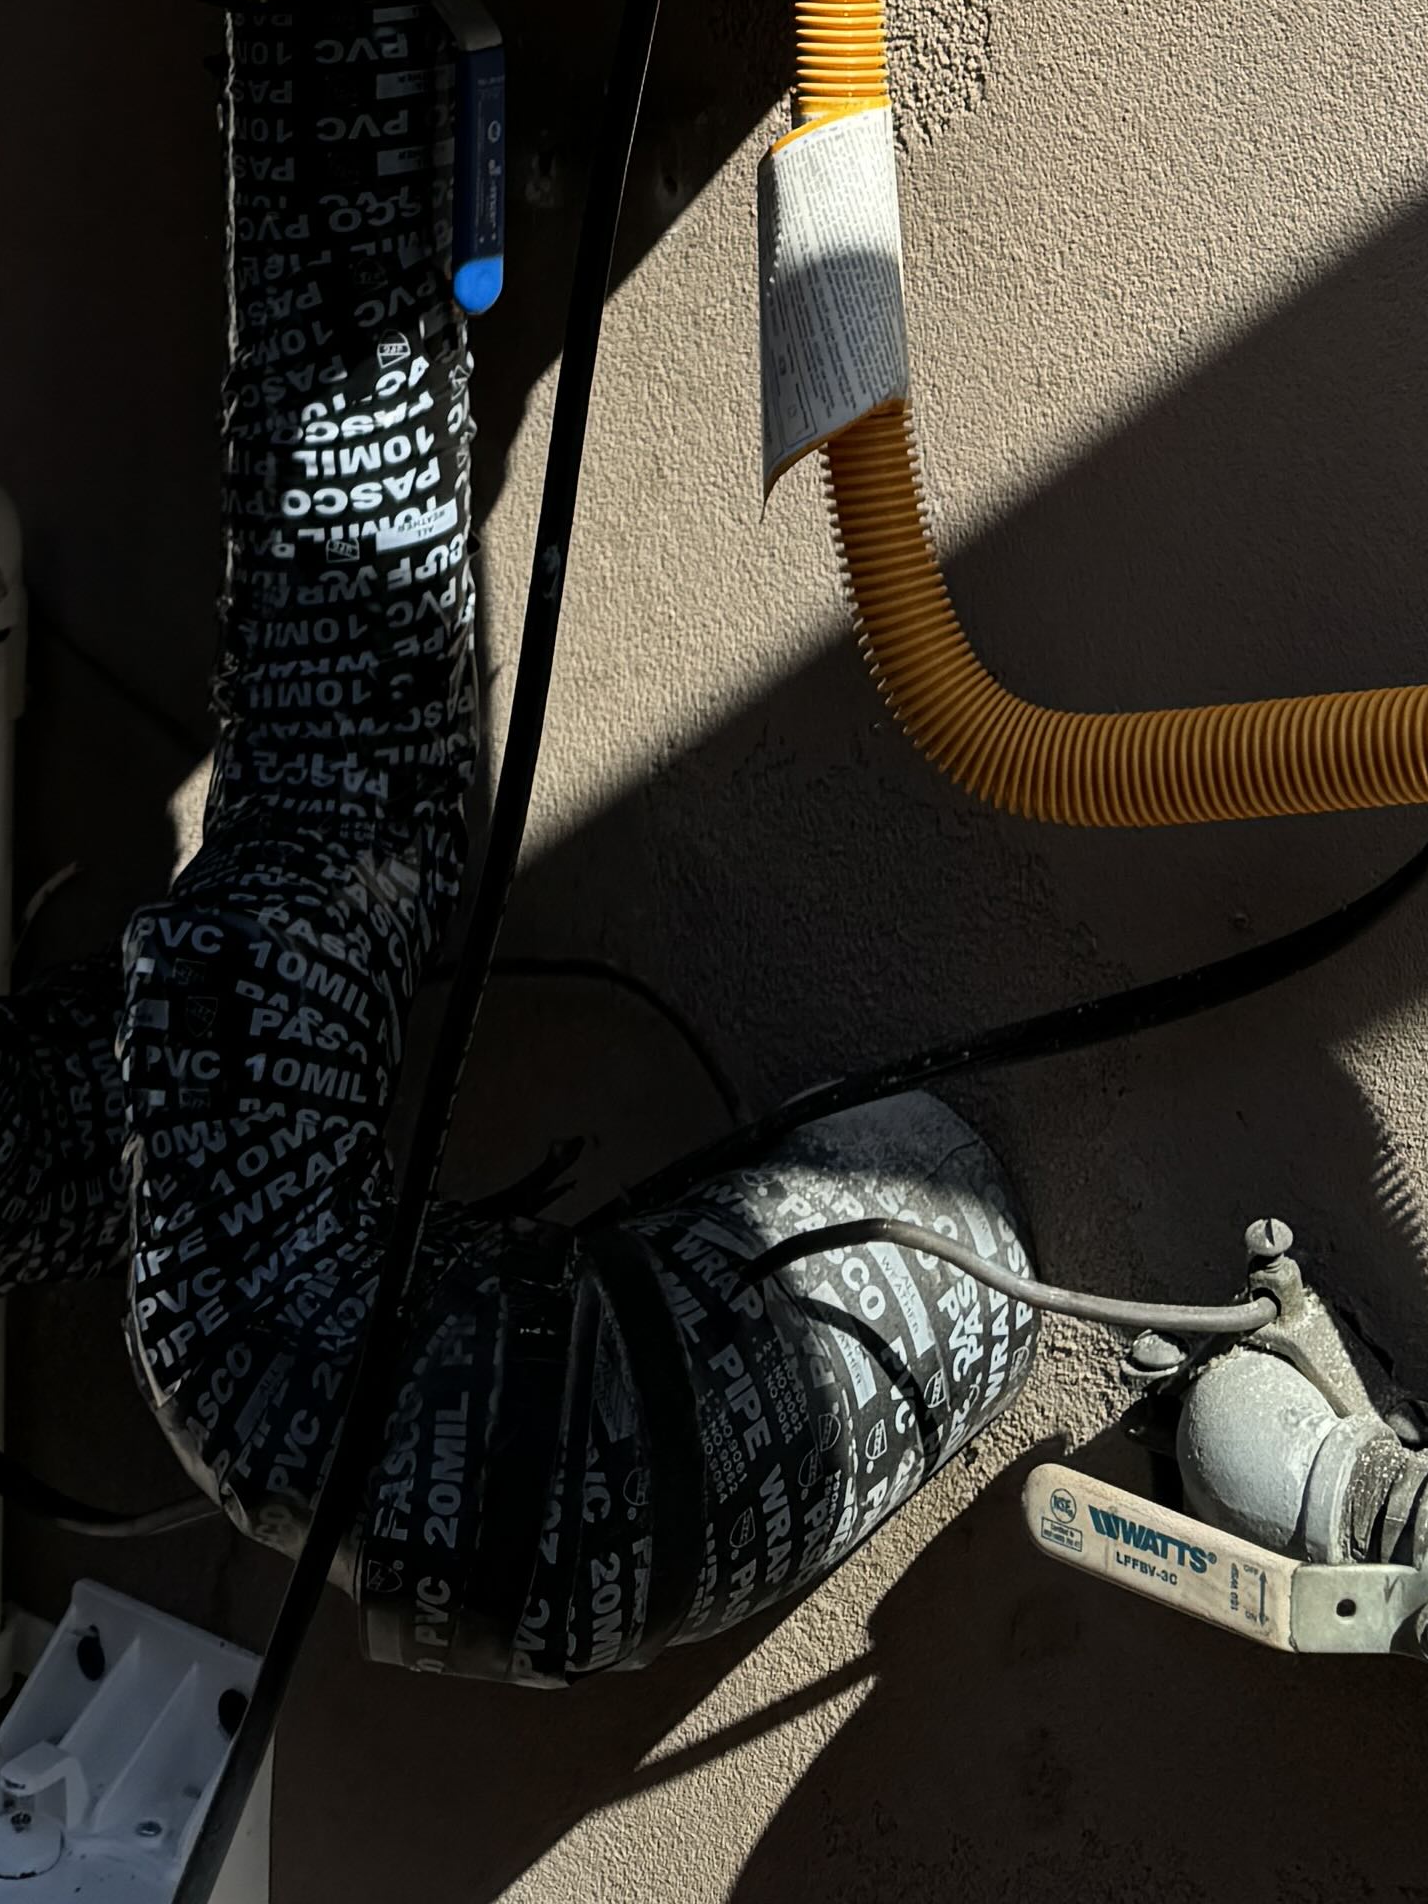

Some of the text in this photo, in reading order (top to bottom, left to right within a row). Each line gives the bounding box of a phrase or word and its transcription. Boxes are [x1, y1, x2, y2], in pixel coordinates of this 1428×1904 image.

[314, 34, 409, 65] PVC
[315, 109, 410, 143] PVC
[280, 456, 442, 520] PASCO
[290, 424, 436, 482] 10MIL
[385, 577, 458, 629] PVC
[134, 917, 373, 1029] PVC 10MIL
[145, 1045, 368, 1106] PVC 10MIL
[218, 1132, 359, 1240] WRAP
[136, 1263, 230, 1334] PVC
[671, 1233, 765, 1323] WRAP
[146, 1295, 231, 1375] PIPE
[266, 1408, 322, 1493] PVC
[422, 1391, 471, 1550] 20MIL
[706, 1342, 773, 1463] PIPE
[758, 1463, 792, 1585] WRAP
[414, 1574, 452, 1648] PVC
[510, 1597, 552, 1680] PVC
